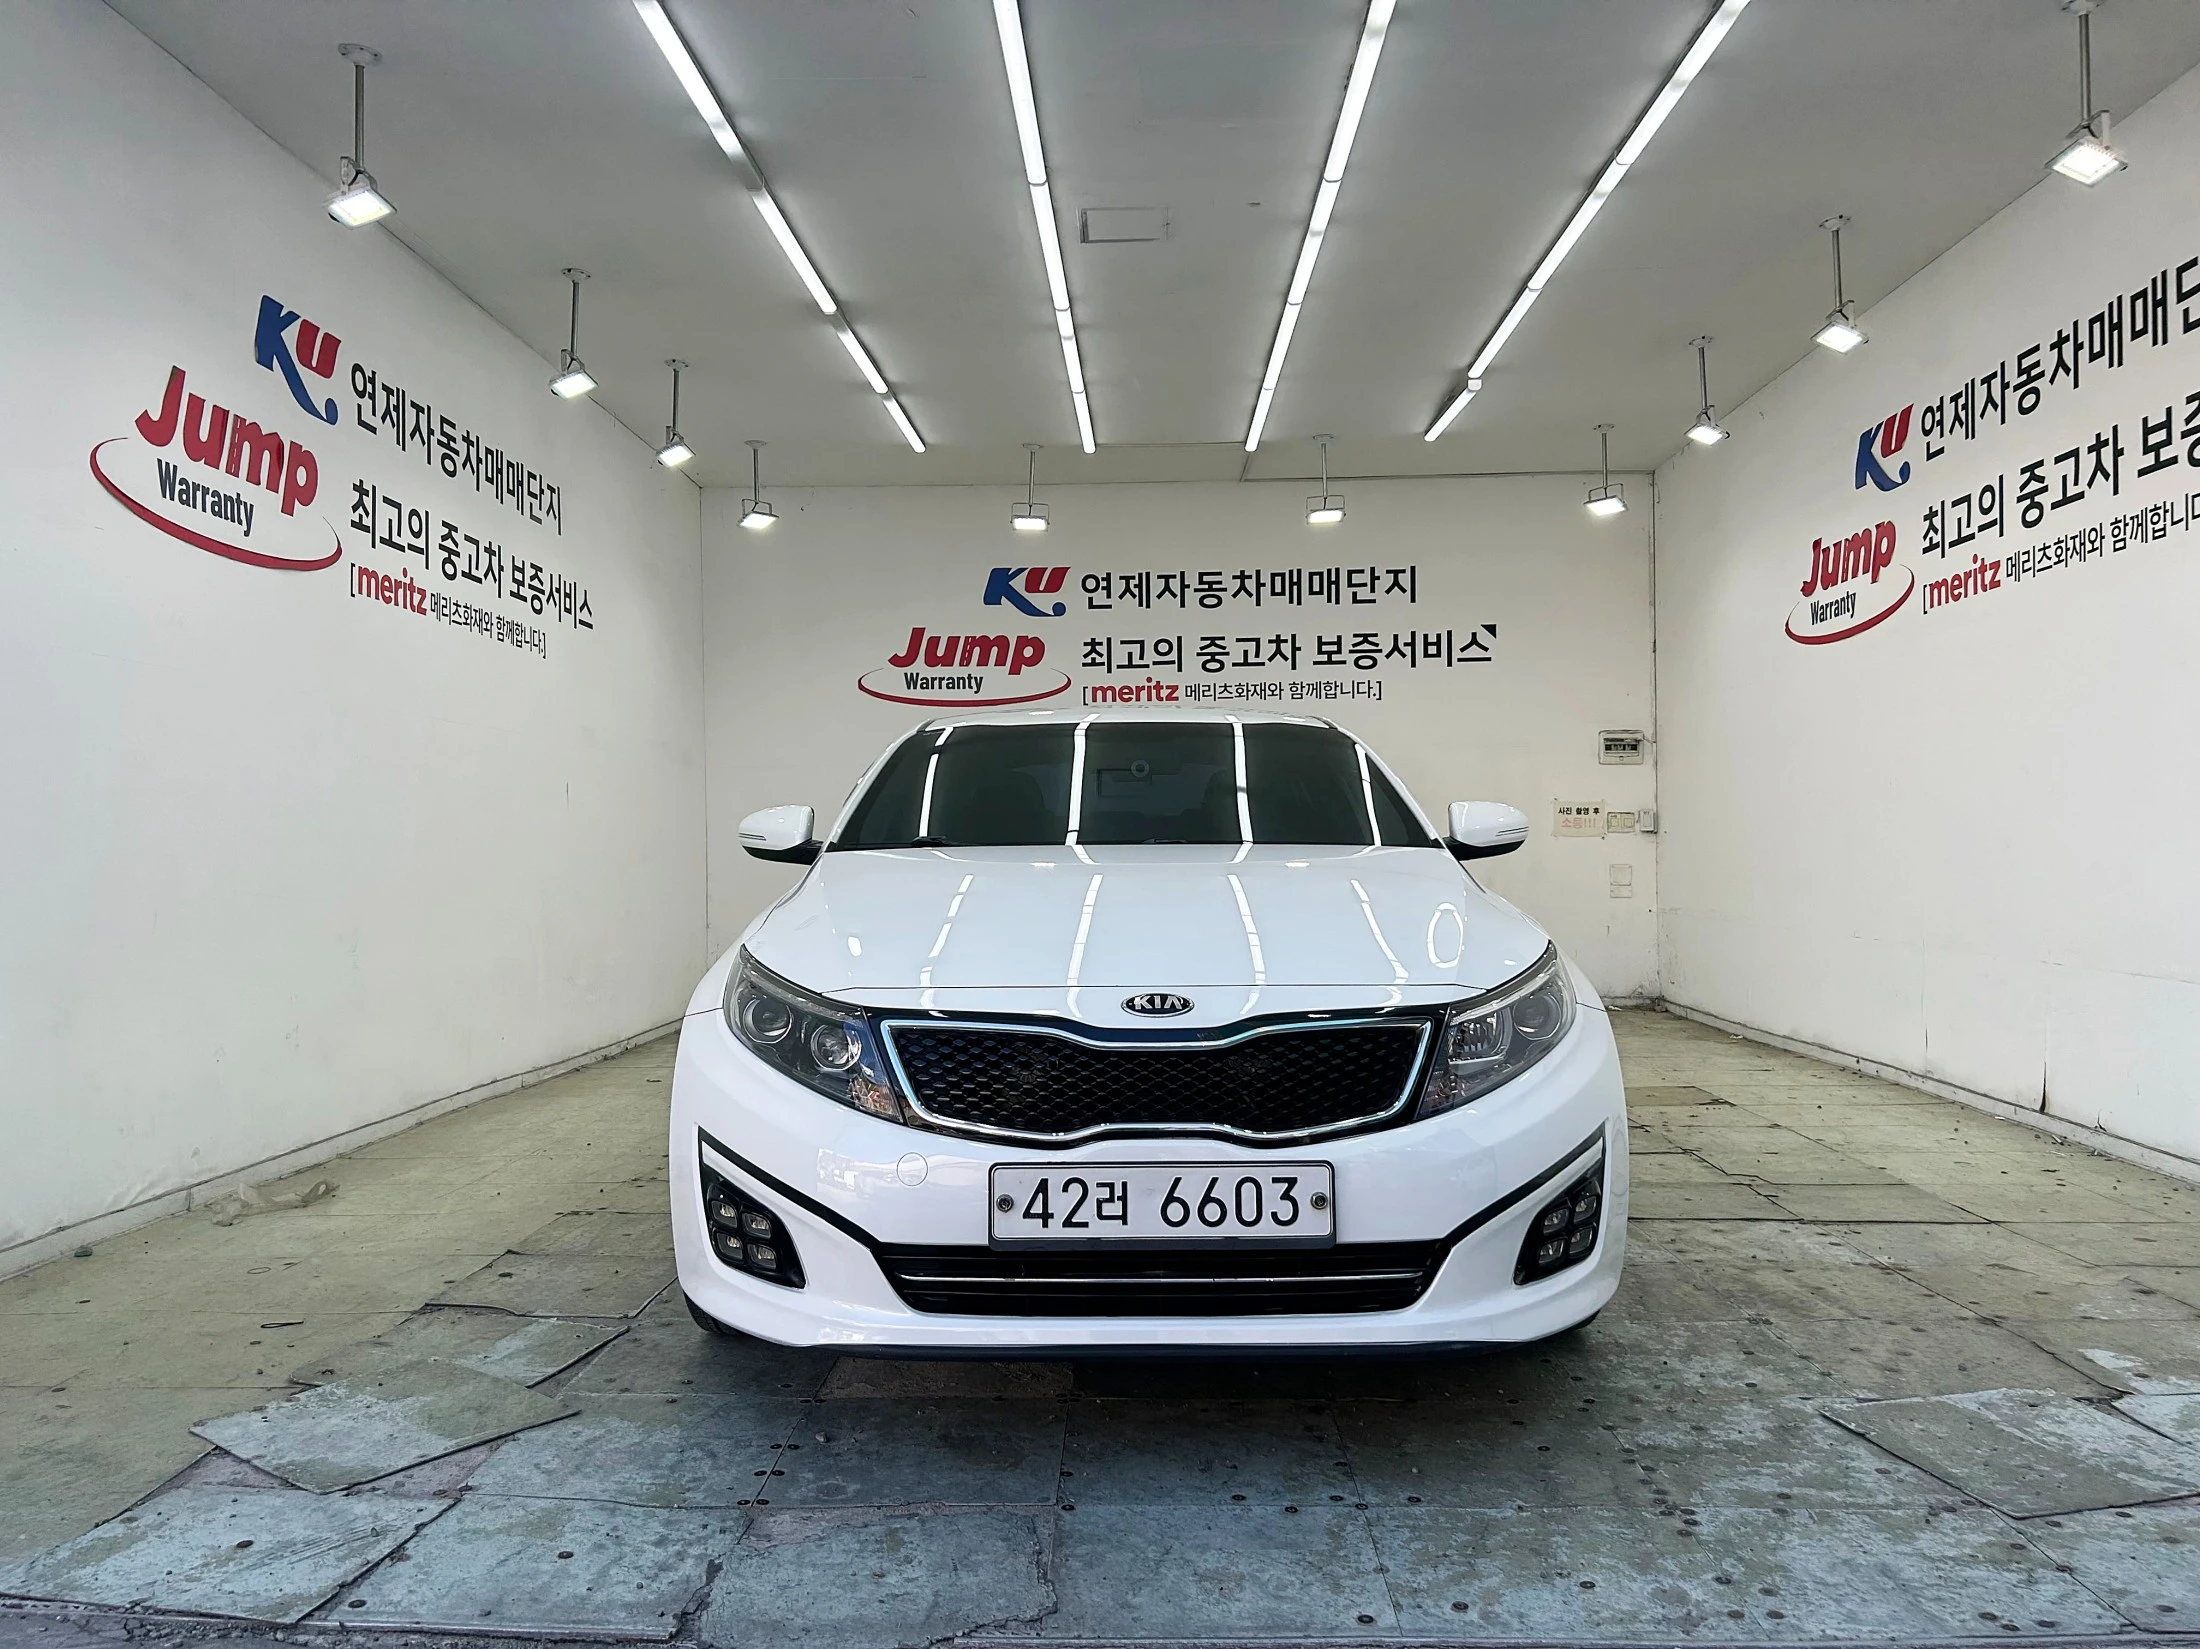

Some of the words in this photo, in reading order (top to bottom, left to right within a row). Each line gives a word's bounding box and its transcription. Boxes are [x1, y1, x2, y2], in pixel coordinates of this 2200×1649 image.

[135, 365, 319, 517] Jump
[350, 362, 563, 536] 연제자동차매매단지
[156, 457, 255, 538] Warranty
[1922, 474, 2004, 560] 최고의
[2016, 423, 2125, 529] 중고차
[350, 478, 430, 571] 최고의
[438, 519, 504, 599] 중고차
[509, 554, 594, 630] 보증서비스
[1799, 519, 1896, 598] Jump
[2005, 522, 2106, 583] 메리츠화재와
[1080, 565, 1419, 611] 연제자동차매매단지
[1810, 590, 1857, 626] Warranty
[430, 591, 494, 639] 메리츠화재와
[887, 626, 1047, 677] Jump
[1081, 635, 1185, 675] 최고의
[1195, 633, 1302, 673] 중고차
[1312, 627, 1494, 672] 보증서비스
[903, 671, 985, 696] Warranty
[1184, 679, 1284, 704] 메리츠화재와
[1558, 807, 1572, 815] 사진
[1592, 807, 1600, 815] 후
[1133, 994, 1184, 1011] KIA
[1022, 1177, 1129, 1229] 42러
[1160, 1176, 1300, 1228] 6603
